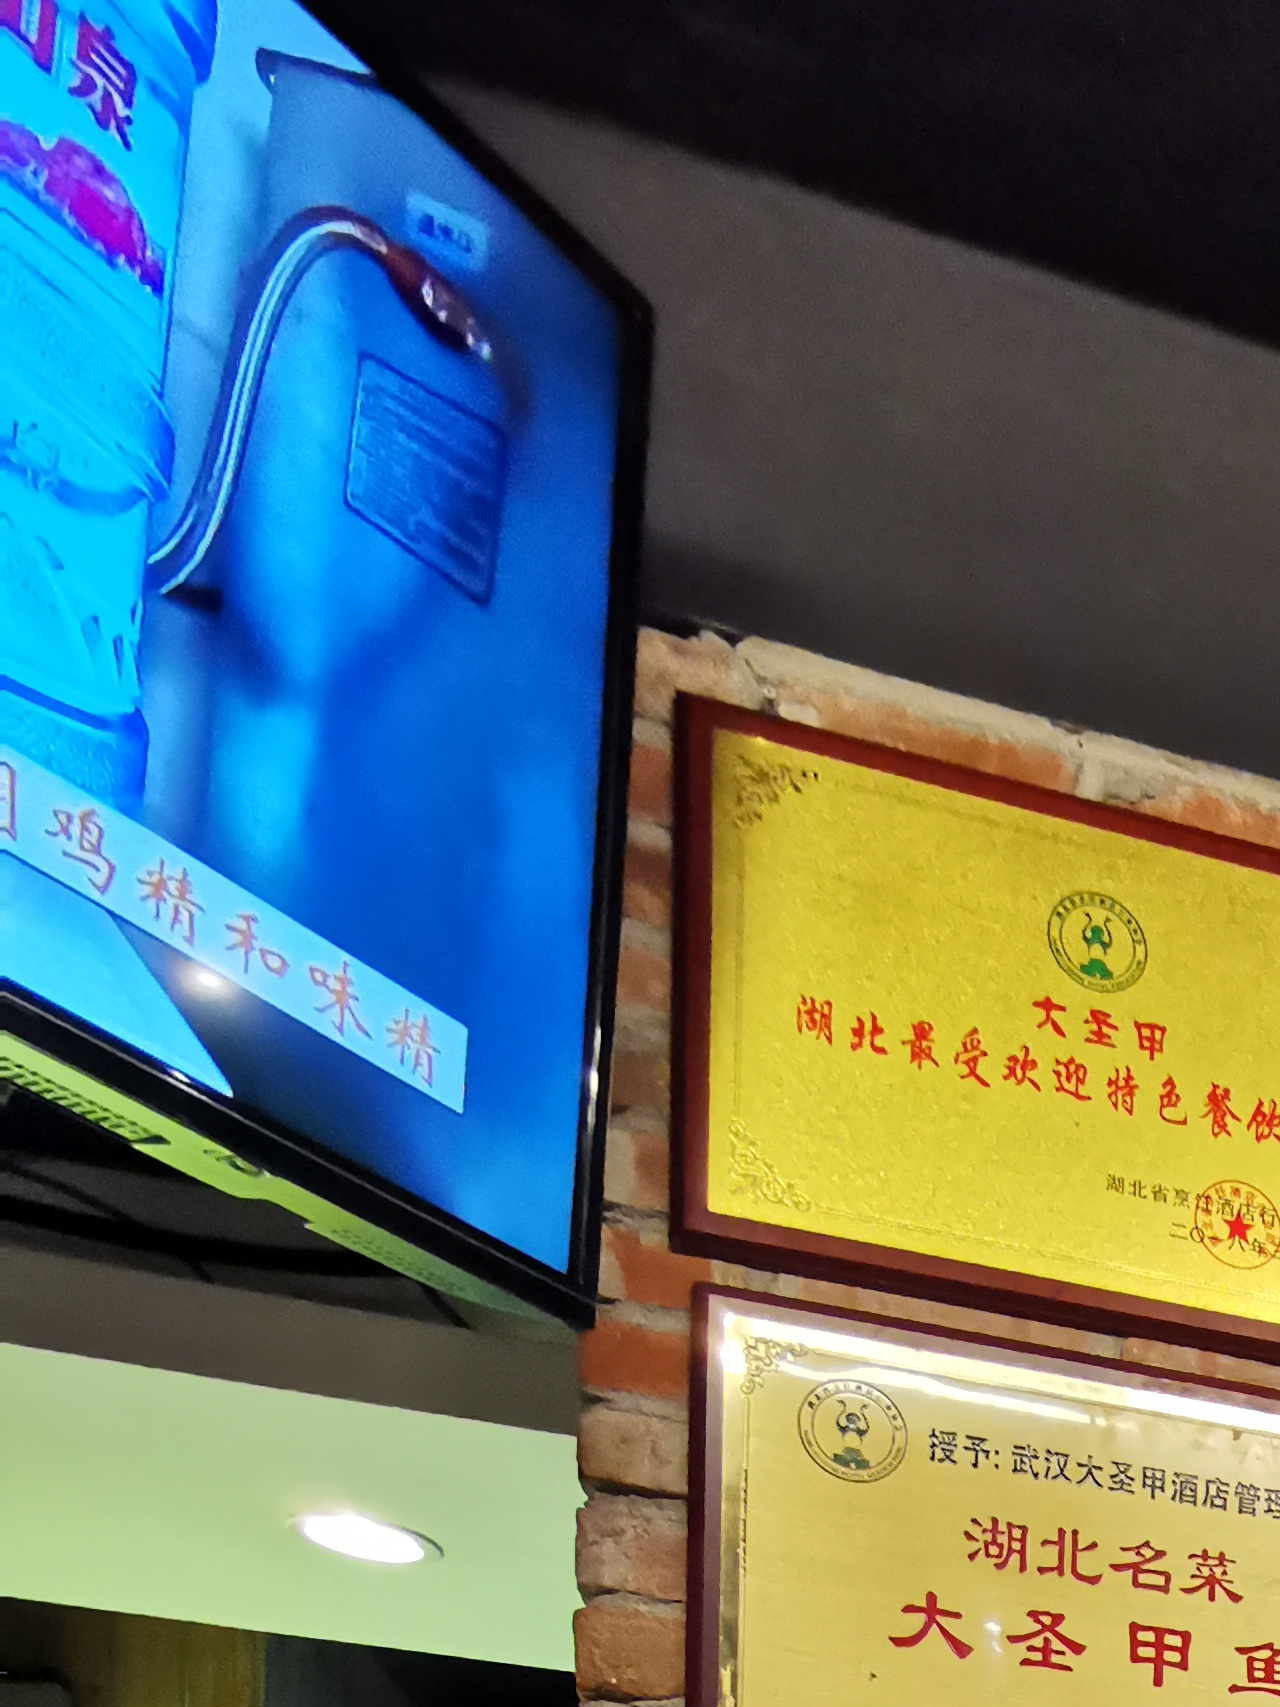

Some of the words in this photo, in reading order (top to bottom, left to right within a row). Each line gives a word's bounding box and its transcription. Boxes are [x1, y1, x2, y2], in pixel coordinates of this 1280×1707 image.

[1033, 997, 1167, 1061] 大圣甲
[964, 1517, 1244, 1604] 湖北名菜
